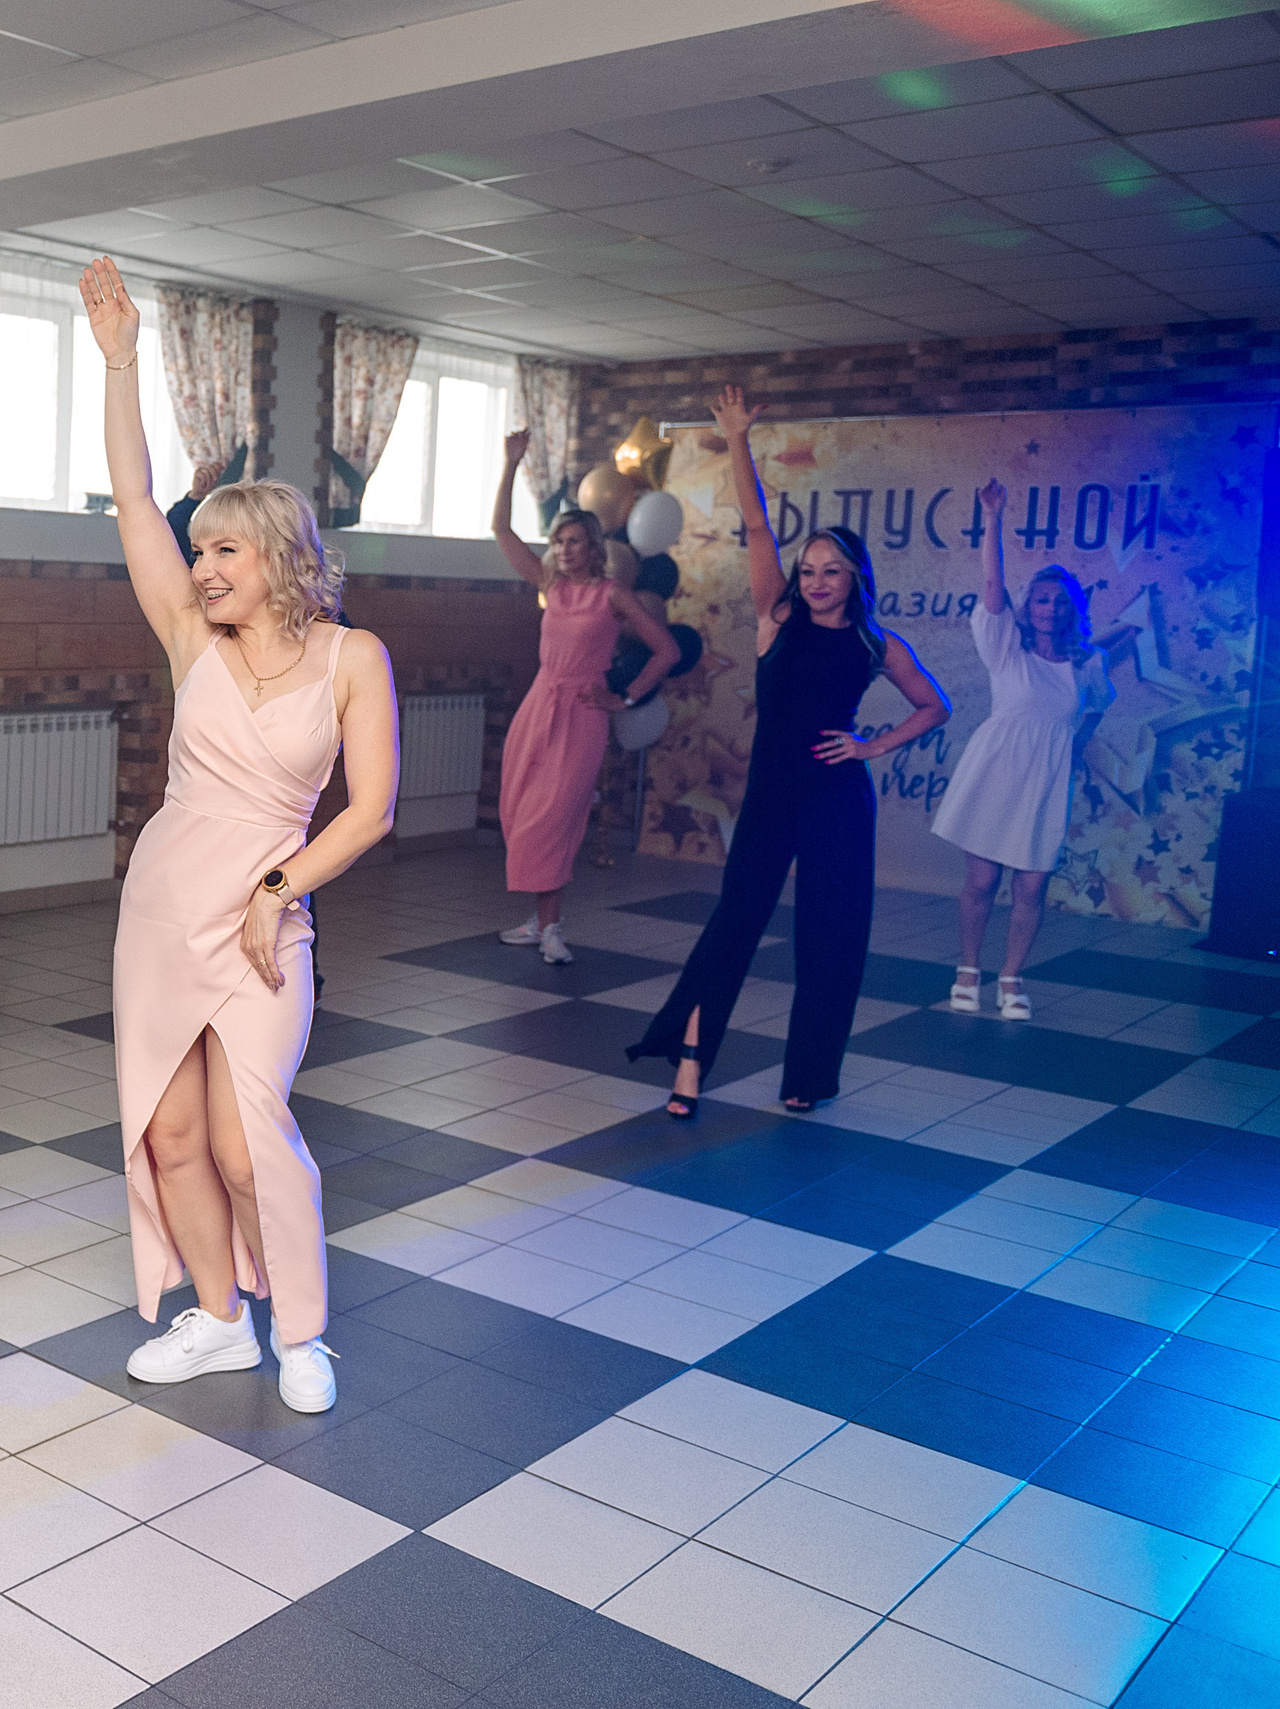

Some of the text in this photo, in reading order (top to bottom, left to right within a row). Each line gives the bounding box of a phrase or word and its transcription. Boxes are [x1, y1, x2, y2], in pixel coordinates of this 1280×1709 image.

[732, 474, 1161, 550] ЫПУСНОЙ
[879, 590, 978, 618] азия
[881, 770, 949, 813] пер
